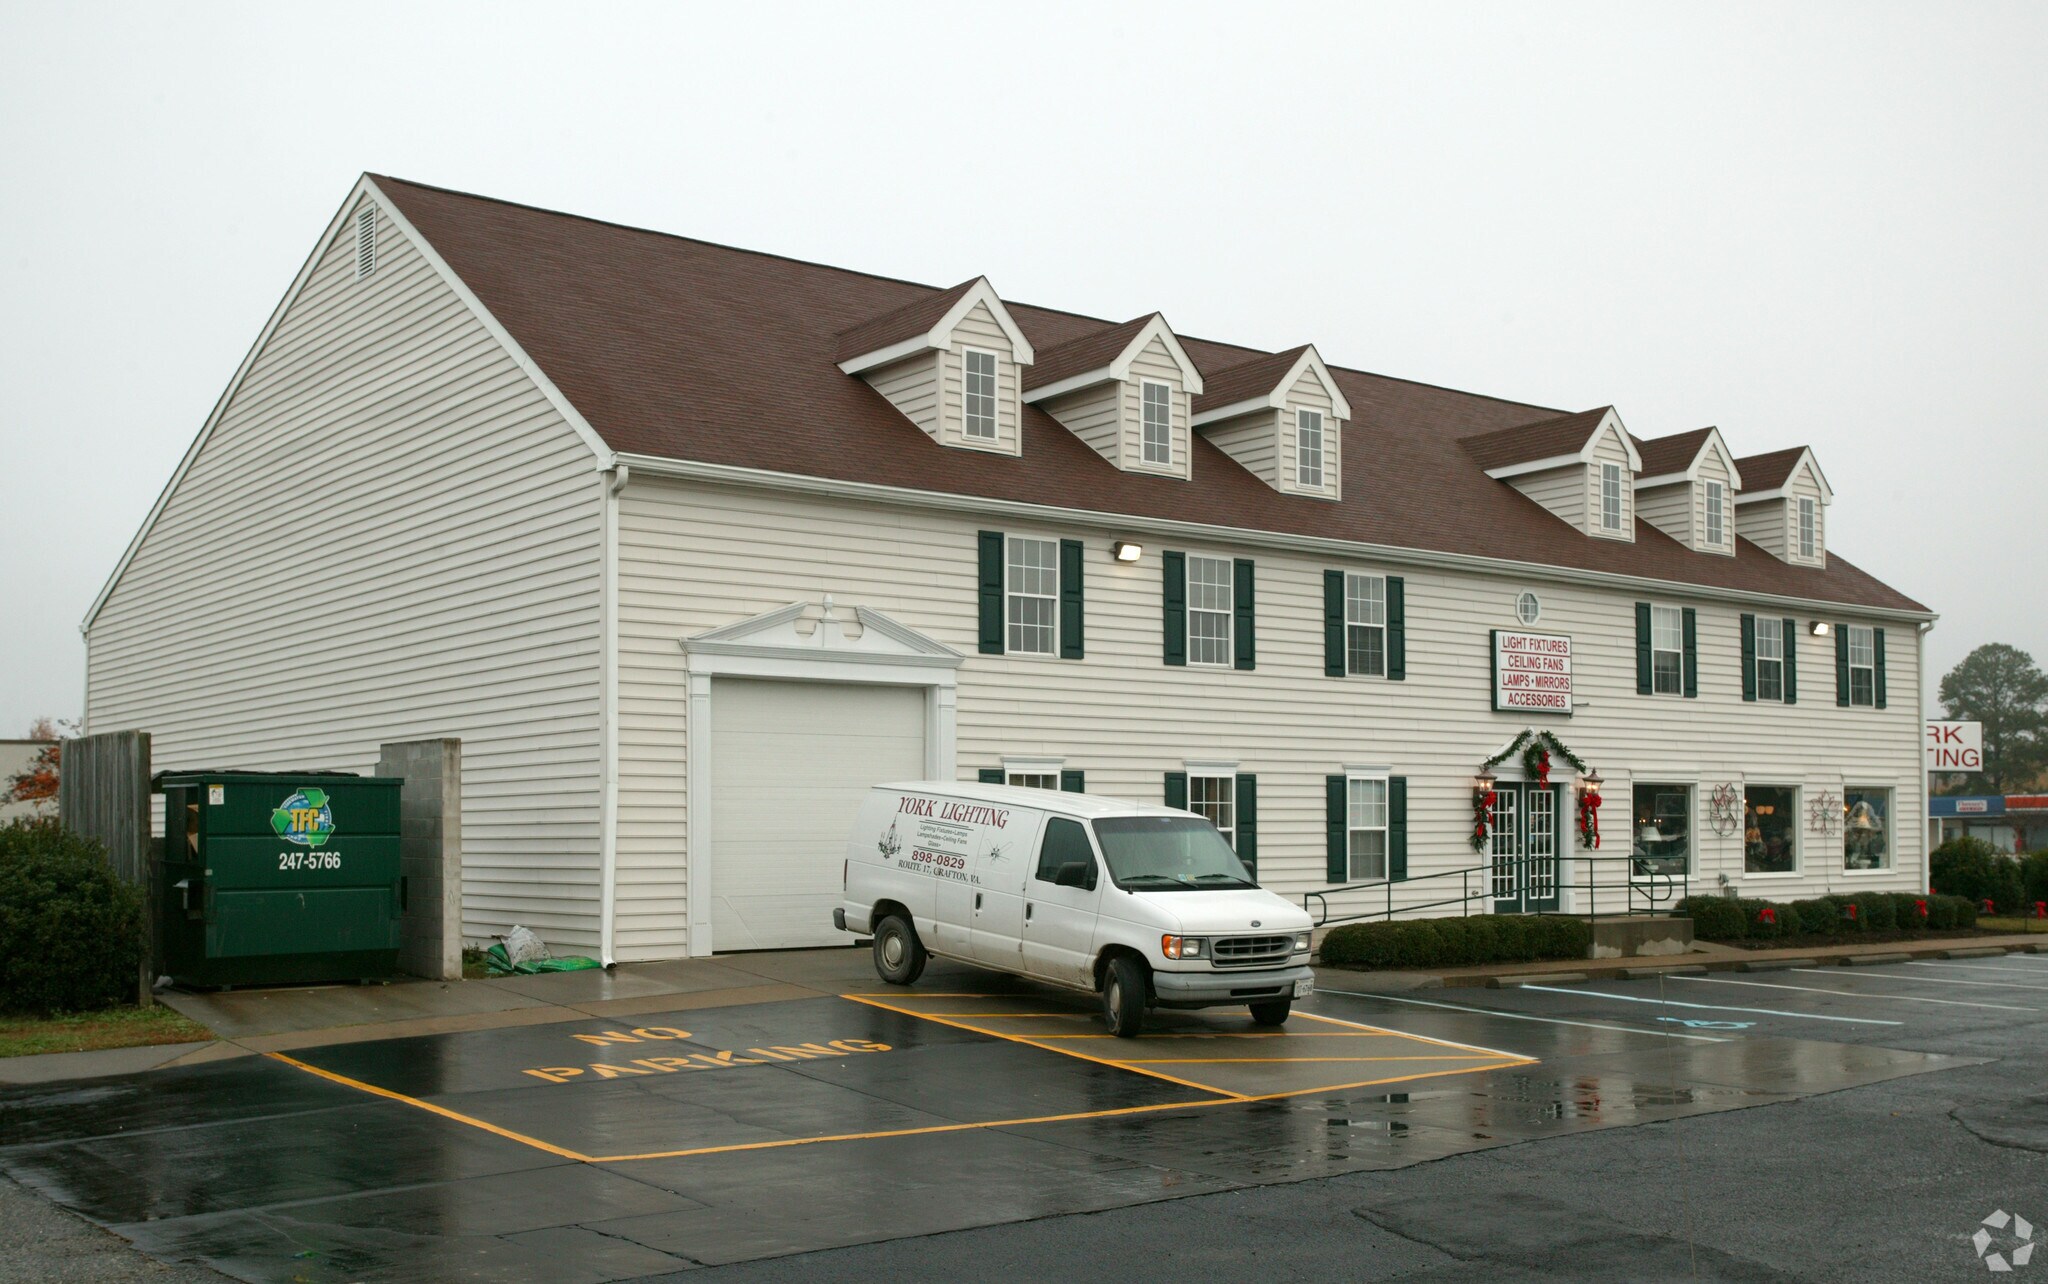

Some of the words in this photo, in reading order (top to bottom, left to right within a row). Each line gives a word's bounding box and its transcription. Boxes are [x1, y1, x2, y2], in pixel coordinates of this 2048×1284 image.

[1502, 636, 1527, 650] LIGHT
[1529, 638, 1568, 653] FIXTURES
[1508, 655, 1541, 669] CEILING
[1543, 657, 1564, 671] FANS
[1502, 674, 1530, 687] LAMPS
[1535, 675, 1570, 690] MIRRORS
[1507, 692, 1566, 708] ACCESSORIES
[291, 808, 319, 832] TFC
[897, 796, 938, 817] YORK
[940, 802, 1010, 829] LIGHTING
[279, 851, 341, 870] 247-5766
[898, 860, 921, 872] ROUTE
[911, 850, 965, 869] 898-0829
[570, 1027, 693, 1046] NO
[521, 1039, 893, 1082] PARKING
